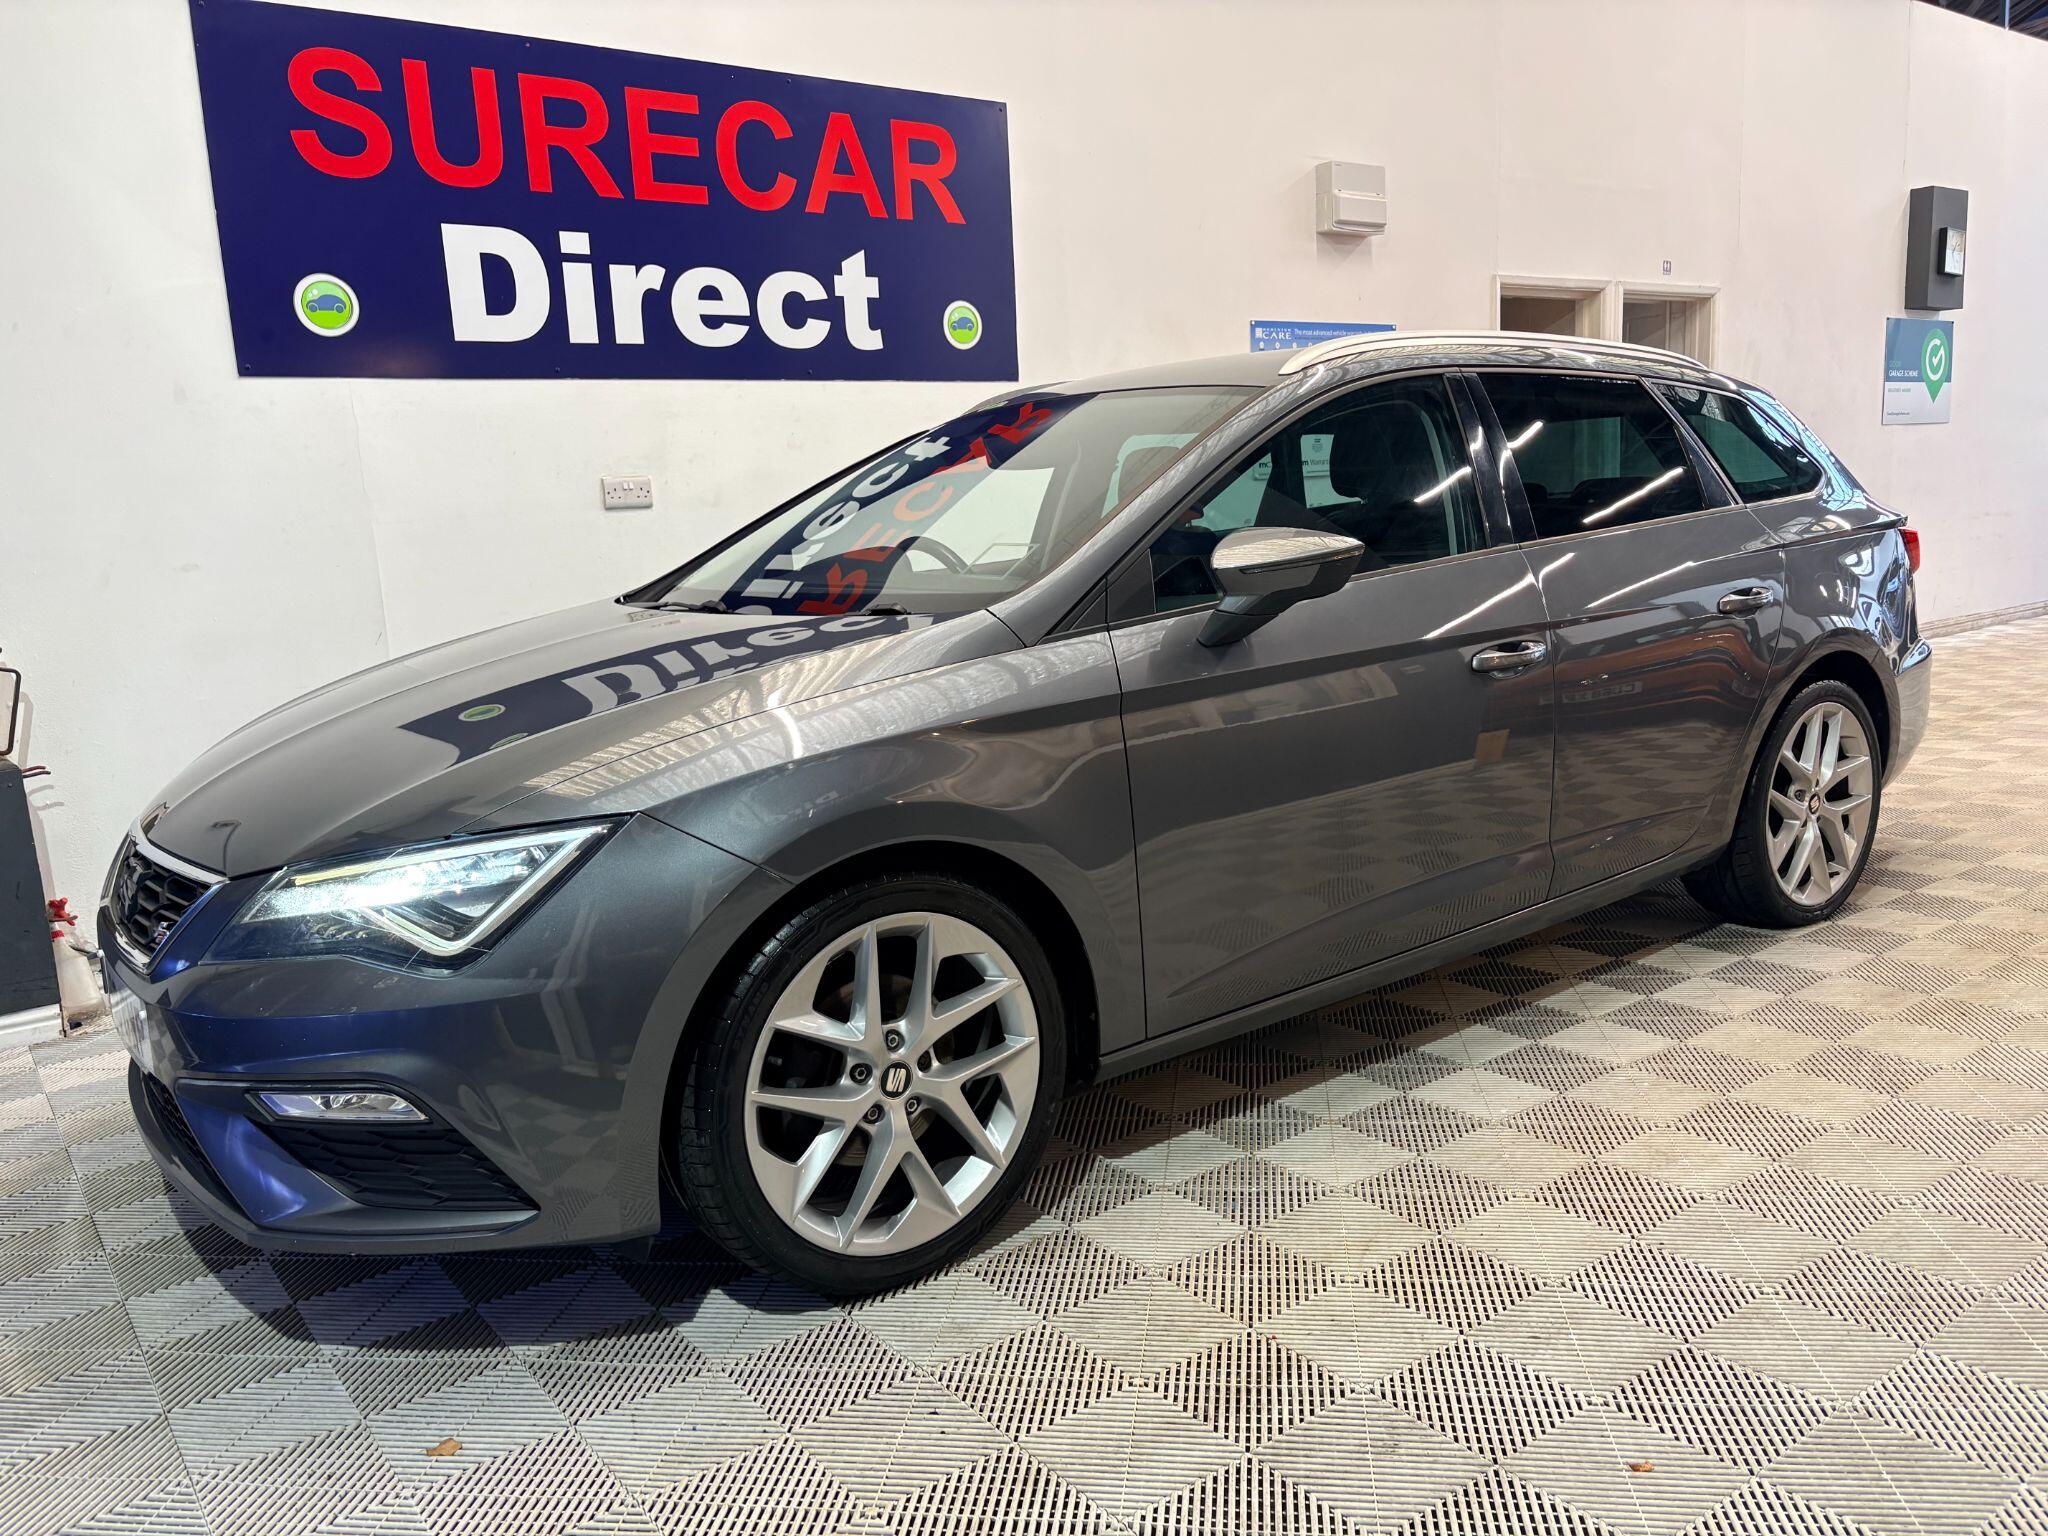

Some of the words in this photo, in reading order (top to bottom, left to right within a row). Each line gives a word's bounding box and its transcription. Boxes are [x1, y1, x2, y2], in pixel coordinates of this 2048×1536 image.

[287, 47, 967, 225] SURECAR
[440, 222, 885, 351] Direct
[1262, 331, 1292, 340] CARE
